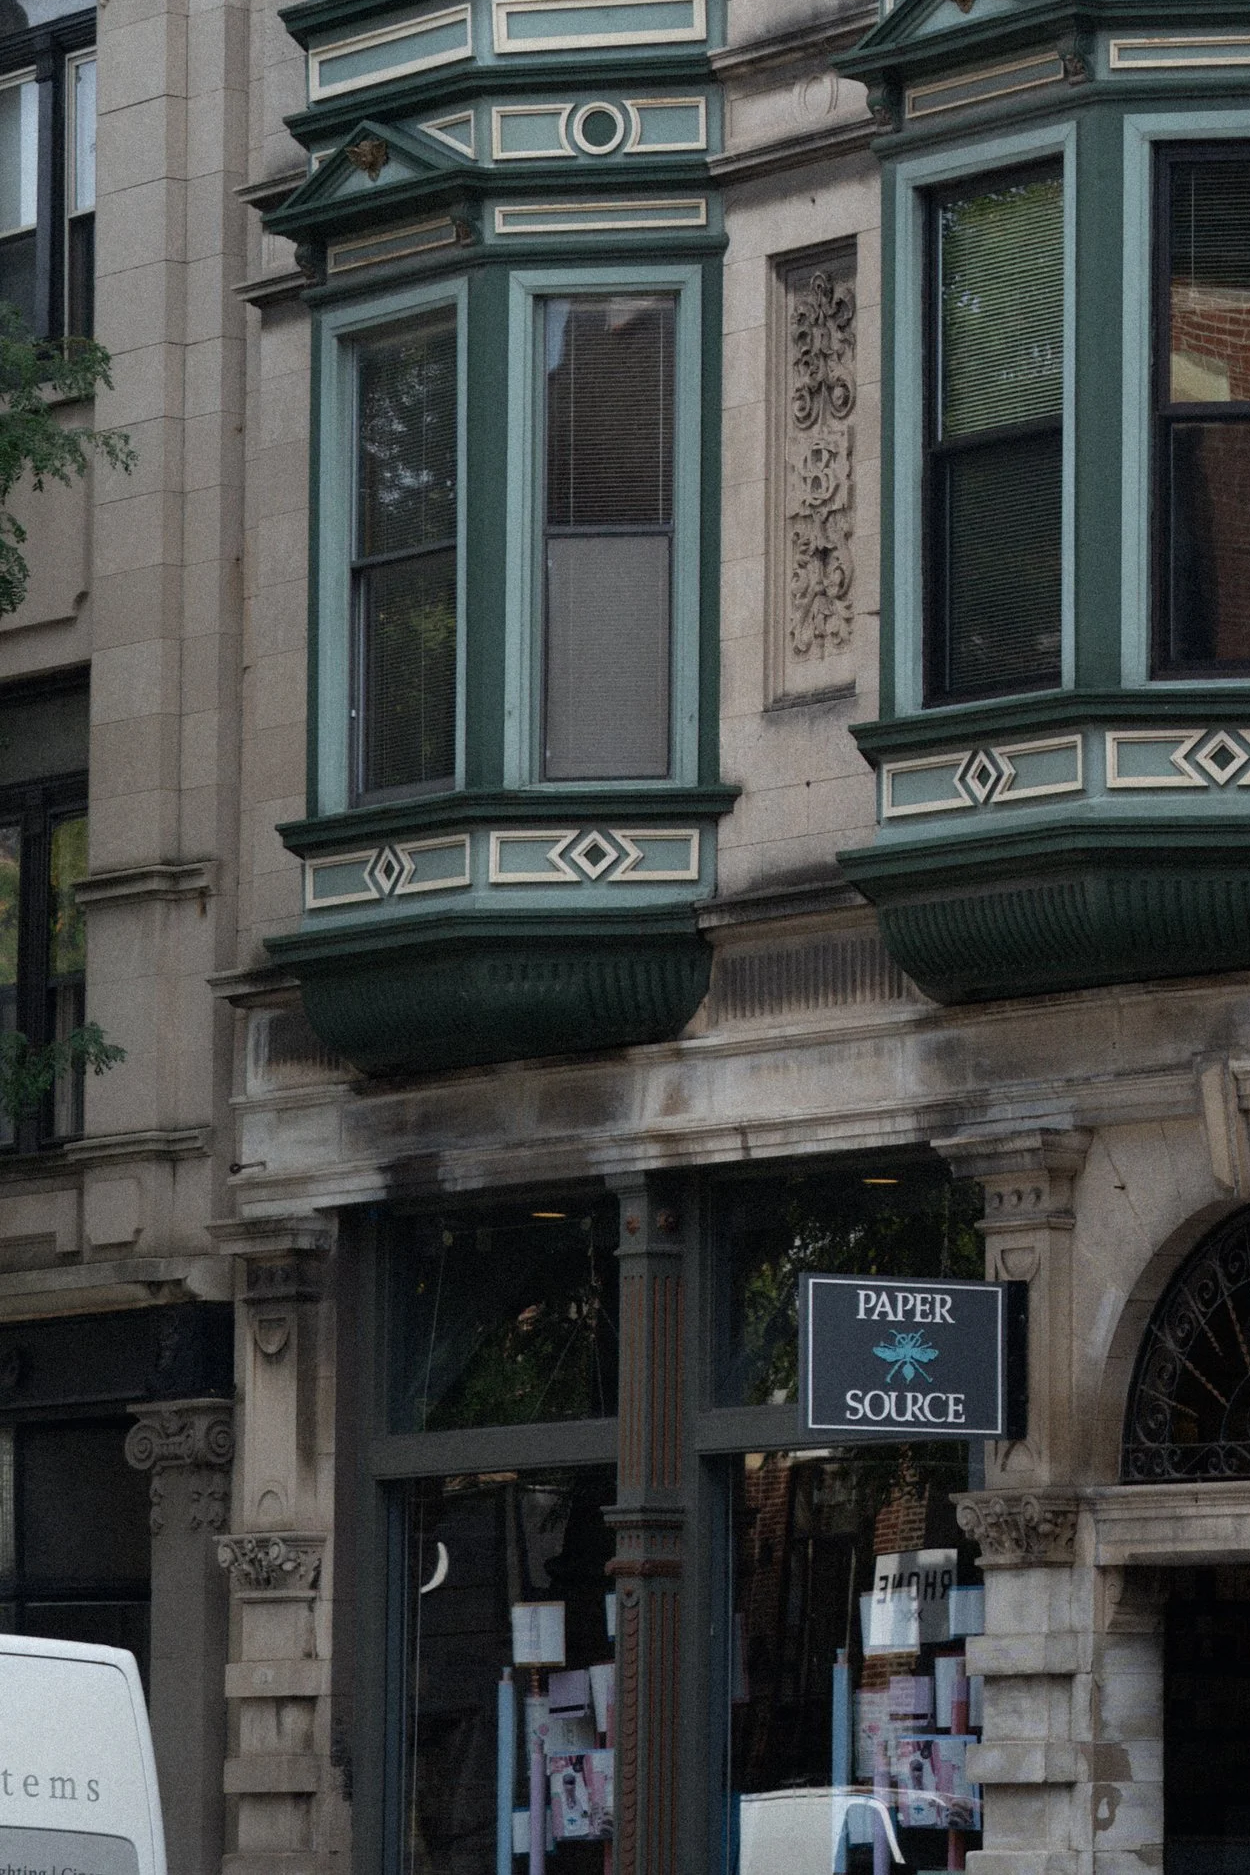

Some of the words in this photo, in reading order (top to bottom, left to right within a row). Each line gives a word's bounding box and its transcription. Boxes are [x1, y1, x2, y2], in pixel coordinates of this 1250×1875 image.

[856, 1289, 956, 1324] PAPER
[845, 1389, 966, 1424] SOURCE
[0, 1768, 100, 1803] tems
